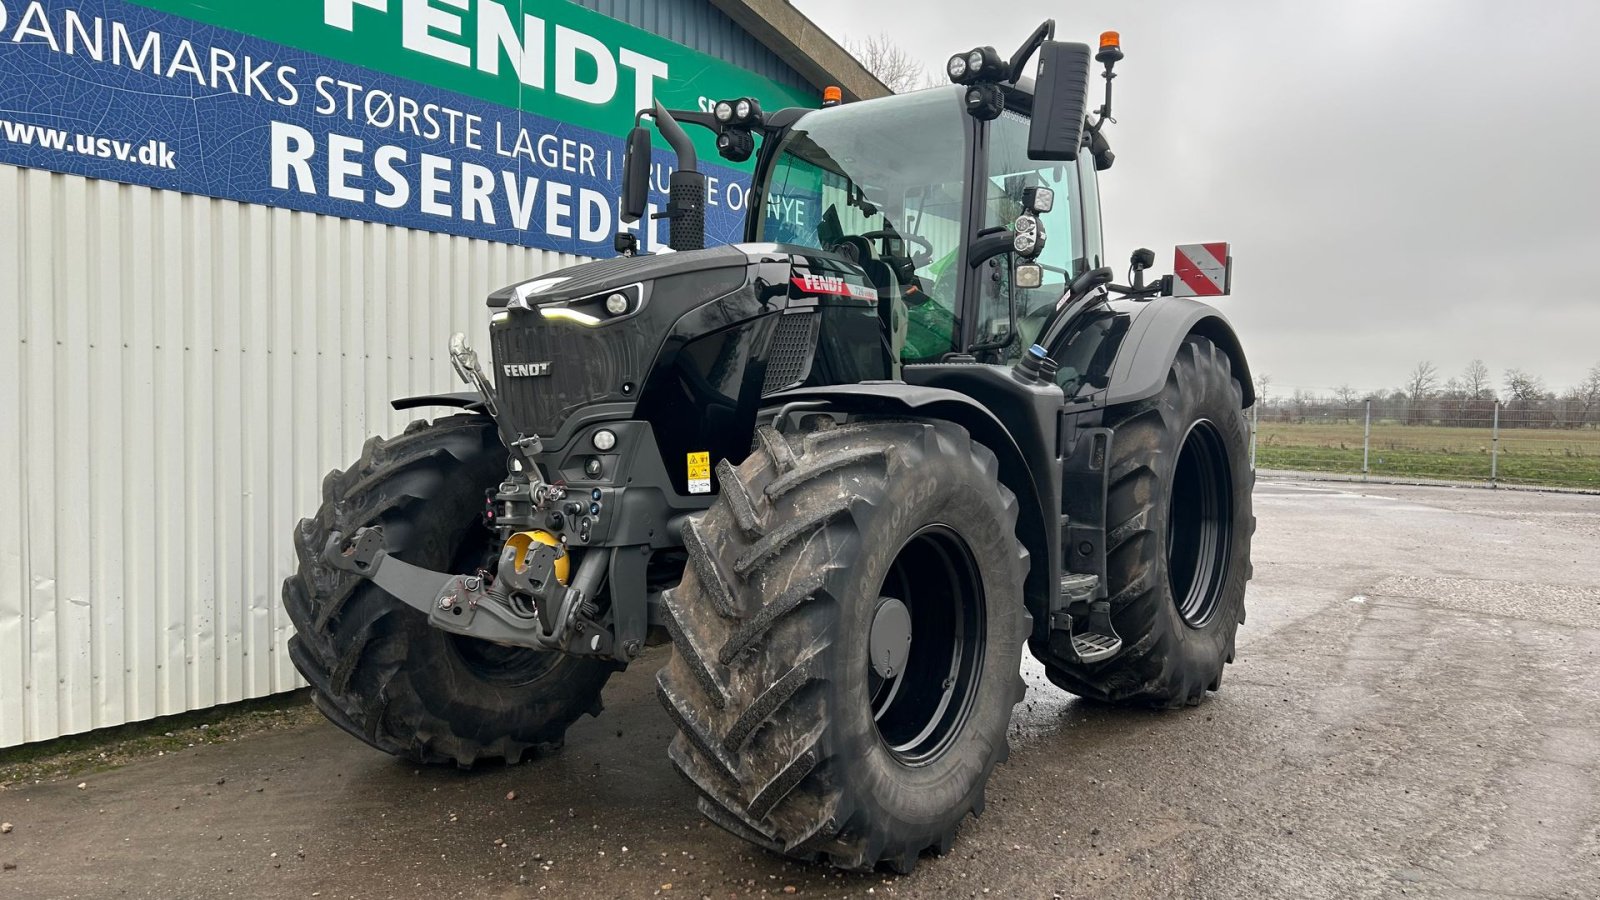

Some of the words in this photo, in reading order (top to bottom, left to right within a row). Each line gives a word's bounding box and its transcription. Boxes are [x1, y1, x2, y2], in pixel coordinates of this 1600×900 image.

[0, 1, 299, 106] ANMARKS
[315, 76, 482, 150] STØRSTE
[496, 121, 596, 177] LAGER
[606, 150, 612, 181] I
[766, 192, 805, 226] NYE
[0, 119, 176, 170] ww.usv.dk
[802, 273, 844, 293] FENDT
[503, 362, 552, 378] FENDT
